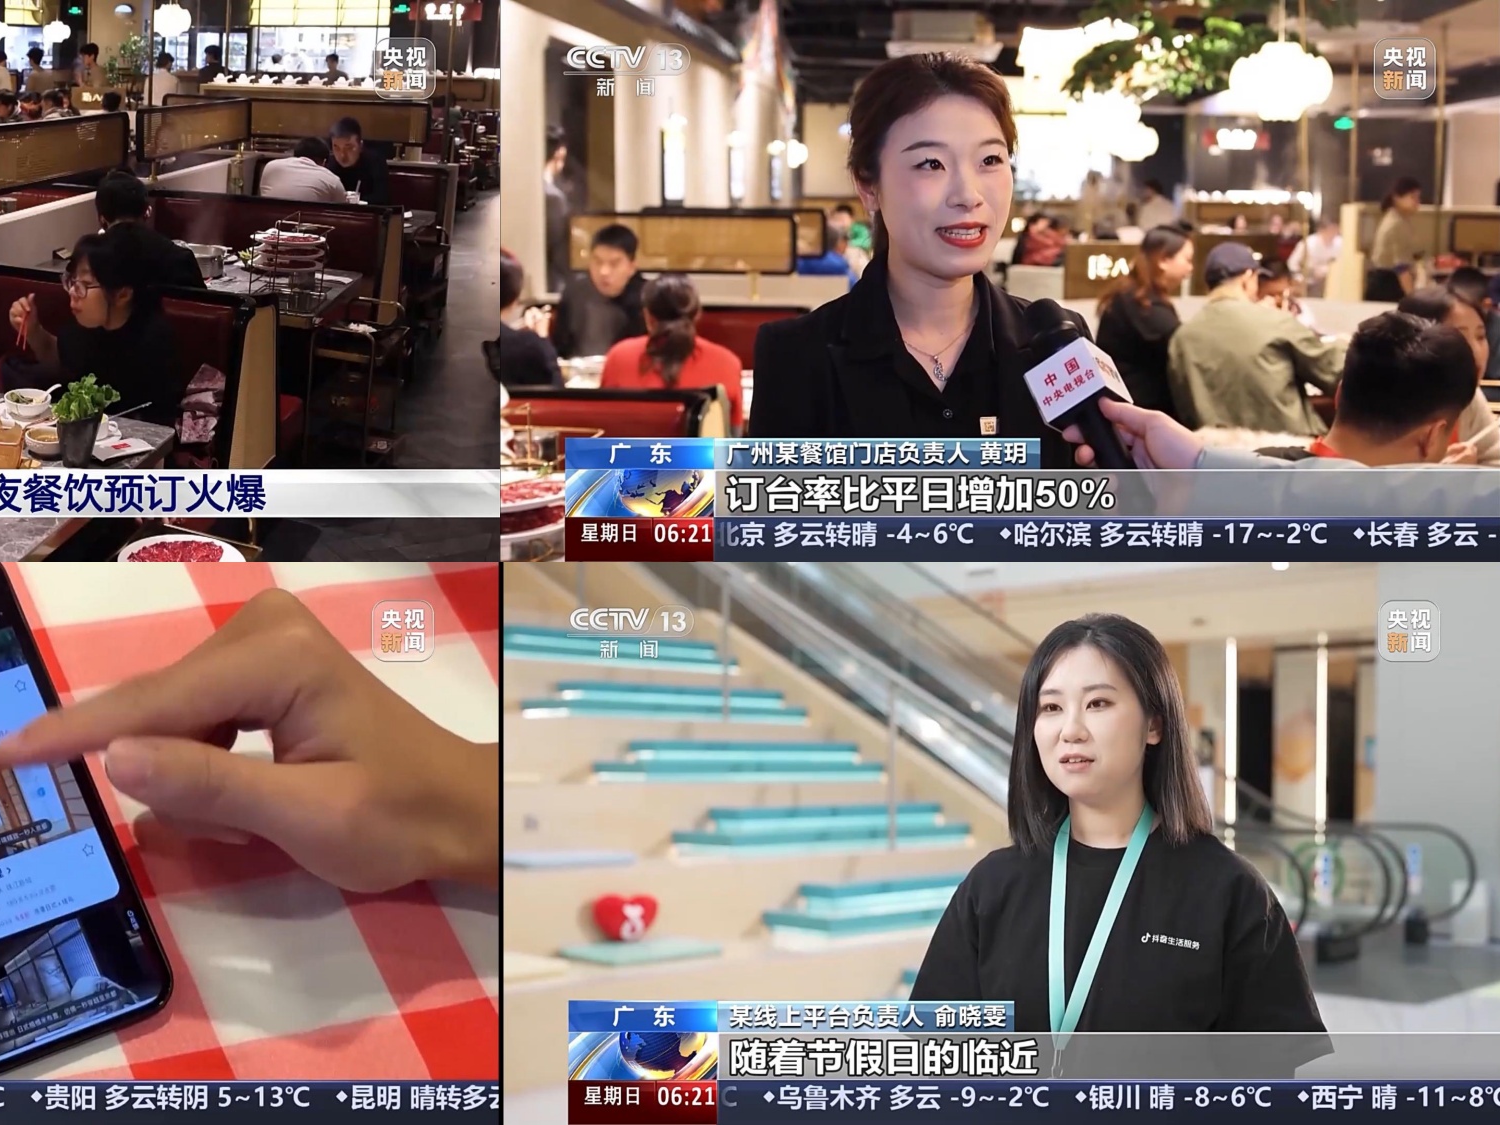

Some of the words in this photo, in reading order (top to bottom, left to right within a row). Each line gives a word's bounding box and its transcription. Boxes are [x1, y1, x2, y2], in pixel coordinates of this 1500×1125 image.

[1044, 357, 1080, 387] 中国
[1042, 369, 1095, 407] 中央电视台
[1151, 934, 1200, 950] 抖音生活服务
